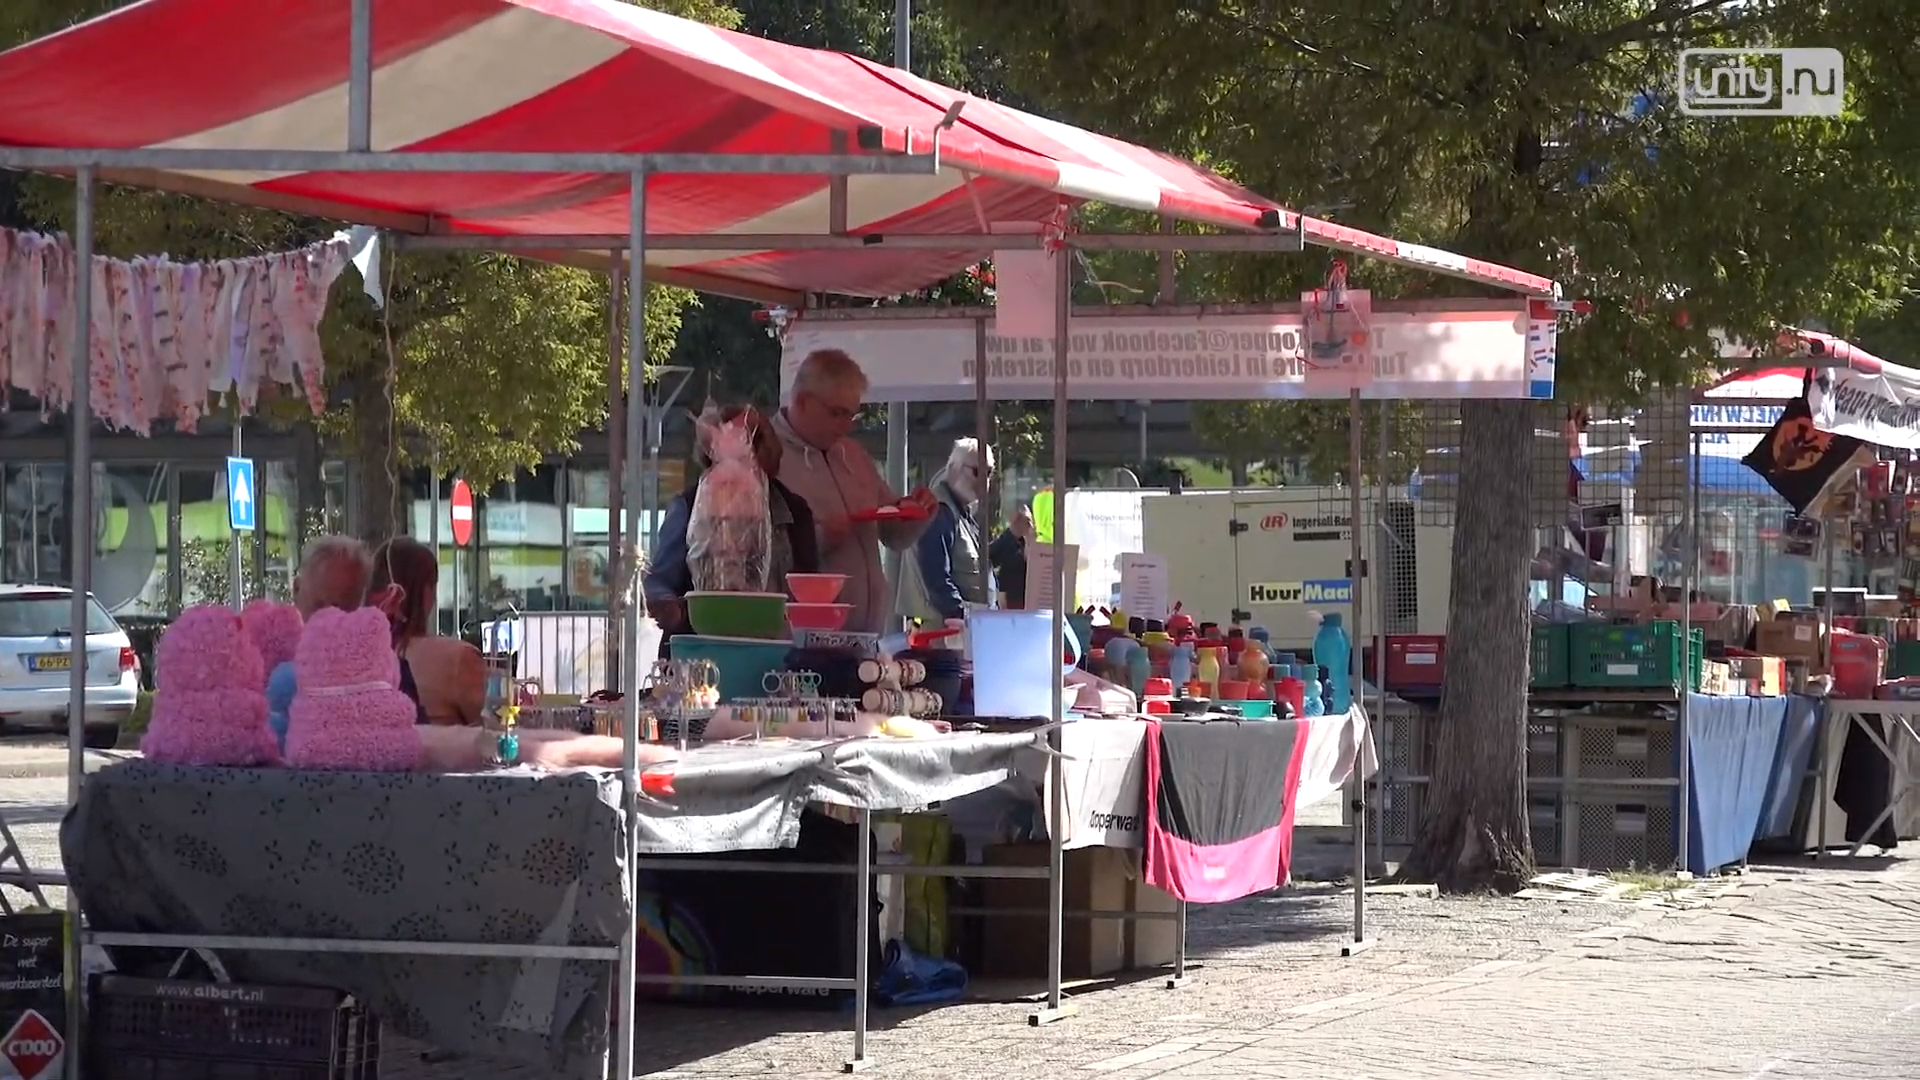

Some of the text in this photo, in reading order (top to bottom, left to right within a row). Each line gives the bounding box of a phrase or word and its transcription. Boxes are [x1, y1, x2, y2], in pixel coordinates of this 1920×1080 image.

[1292, 515, 1353, 530] Ingersoll-Ran
[3, 933, 52, 953] De super
[17, 955, 37, 968] met
[156, 984, 264, 1002] www.albert.nl
